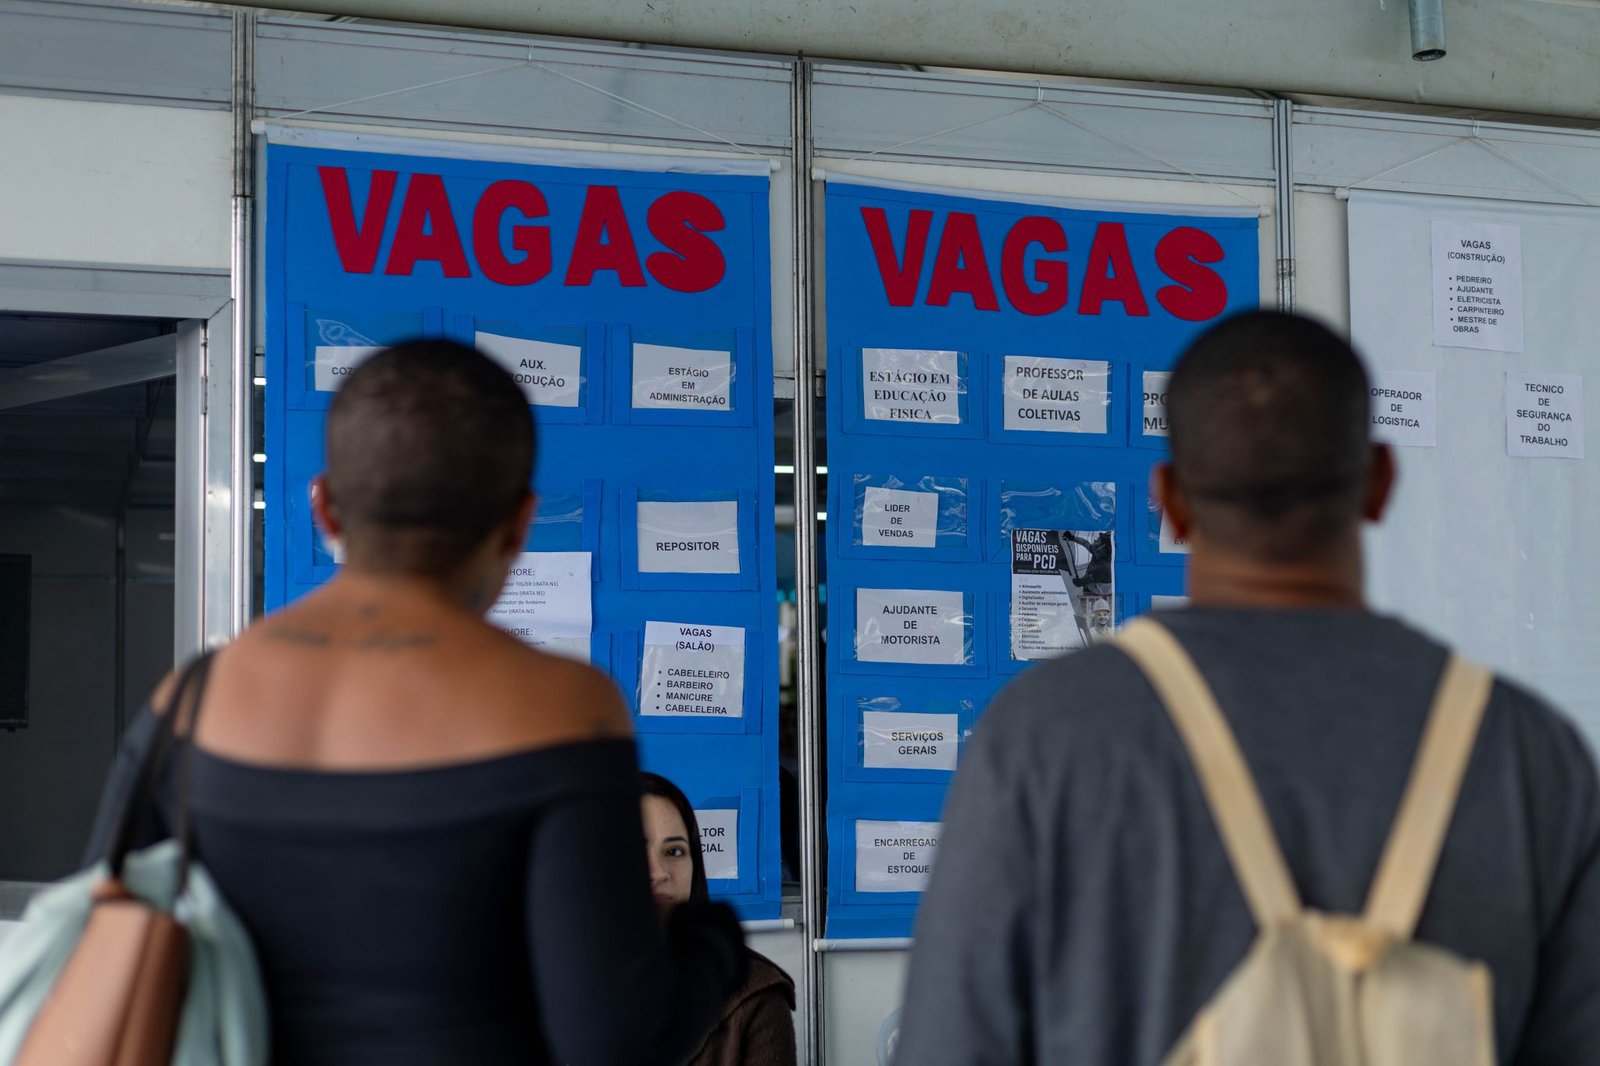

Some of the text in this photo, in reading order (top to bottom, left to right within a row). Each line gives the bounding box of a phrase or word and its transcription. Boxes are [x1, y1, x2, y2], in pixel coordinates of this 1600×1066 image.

[318, 165, 727, 294] VAGAS
[1460, 239, 1492, 250] VAGAS
[1447, 251, 1506, 264] (CONSTRUÇÃO)
[860, 206, 1228, 322] VAGAS
[1456, 275, 1493, 285] PEDREIRO
[1456, 285, 1494, 295] AJUDANTE
[1457, 295, 1502, 306] ELETRICISTA
[1457, 305, 1505, 316] CARPINTEIRO
[1457, 315, 1498, 326] MESTRE DE
[1453, 325, 1480, 334] OBRAS
[519, 358, 547, 371] AUX.
[668, 365, 710, 379] ESTÁGIO
[869, 368, 951, 384] ESTÁGIO EM
[1015, 366, 1084, 382] PROFESSOR
[681, 381, 696, 391] EM
[1524, 383, 1564, 394] TECNICO
[649, 391, 727, 407] ADMINISTRAÇÃO
[873, 388, 947, 405] EDUCAÇÃO
[1022, 388, 1080, 402] DE AULAS
[1370, 387, 1423, 401] OPERADOR
[1390, 403, 1403, 413] DE
[1538, 397, 1550, 407] DE
[889, 408, 932, 420] FISICA
[1017, 407, 1081, 422] COLETIVAS
[1516, 409, 1572, 423] SEGURANÇA
[1372, 416, 1420, 428] LOGISTICA
[1537, 423, 1551, 432] DO
[1520, 435, 1568, 447] TRABALHO
[884, 503, 911, 513] LIDER
[890, 516, 903, 525] DE
[878, 528, 914, 539] VENDAS
[1015, 530, 1047, 544] VAGAS
[656, 541, 720, 552] REPOSITOR
[1015, 543, 1059, 554] DISPONÍVEIS
[1015, 553, 1057, 570] PARA PCD
[882, 604, 938, 617] AJUDANTE
[903, 620, 918, 631] DE
[679, 627, 712, 639] VAGAS
[880, 633, 941, 645] MOTORISTA
[675, 640, 715, 654] (SALÃO)
[667, 668, 730, 680] CABELELEIRO
[666, 680, 714, 691] BARBEIRO
[665, 691, 714, 703] MANICURE
[664, 703, 728, 715] CABELELEIRA
[891, 730, 944, 744] SERVIÇOS
[898, 744, 938, 756] GERAIS
[903, 852, 916, 860] DE
[887, 865, 930, 875] ESTOQUE
